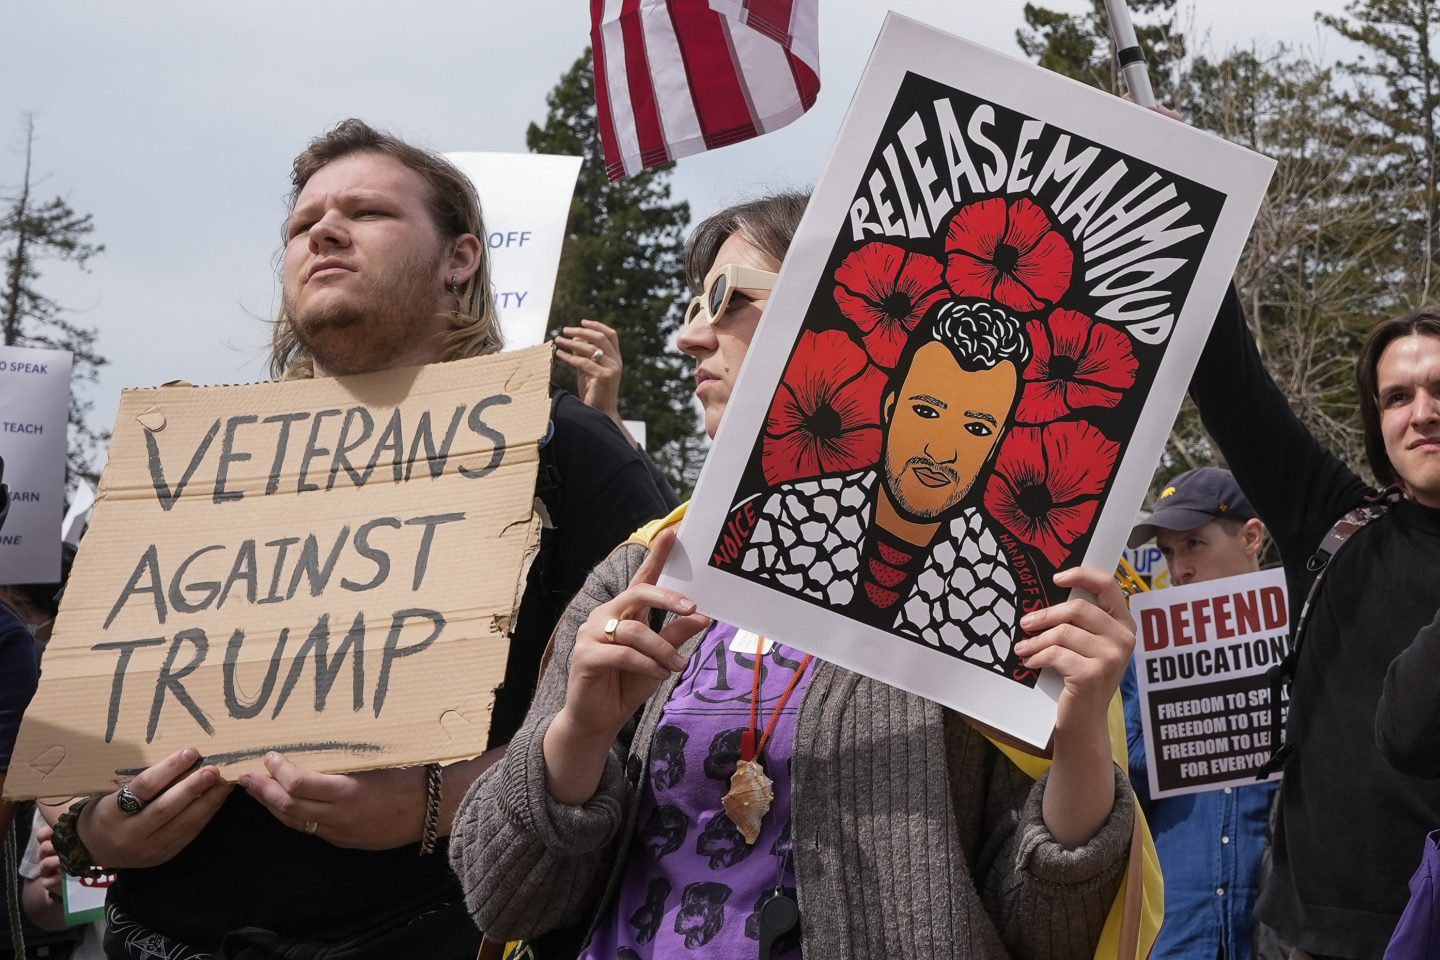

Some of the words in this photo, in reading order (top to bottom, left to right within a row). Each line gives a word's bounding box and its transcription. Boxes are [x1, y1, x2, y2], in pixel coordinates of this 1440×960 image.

[850, 98, 1046, 241] RELEASE
[1031, 134, 1205, 344] MAHMOUD
[489, 231, 531, 249] OFF
[10, 362, 48, 374] SPEAK
[3, 421, 43, 434] TEACH
[144, 394, 512, 512] VETERANS
[9, 491, 40, 502] ARN
[103, 511, 467, 631] AGAINST
[1140, 586, 1287, 651] DEFEND
[91, 607, 448, 744] TRUMP
[1157, 696, 1225, 720] FREEDOM
[1226, 692, 1246, 709] TO
[1160, 716, 1227, 740] FREEDOM
[1228, 713, 1248, 731] TO
[1162, 737, 1229, 760] FREEDOM
[1231, 734, 1250, 750] TO
[1180, 761, 1208, 779] FOR
